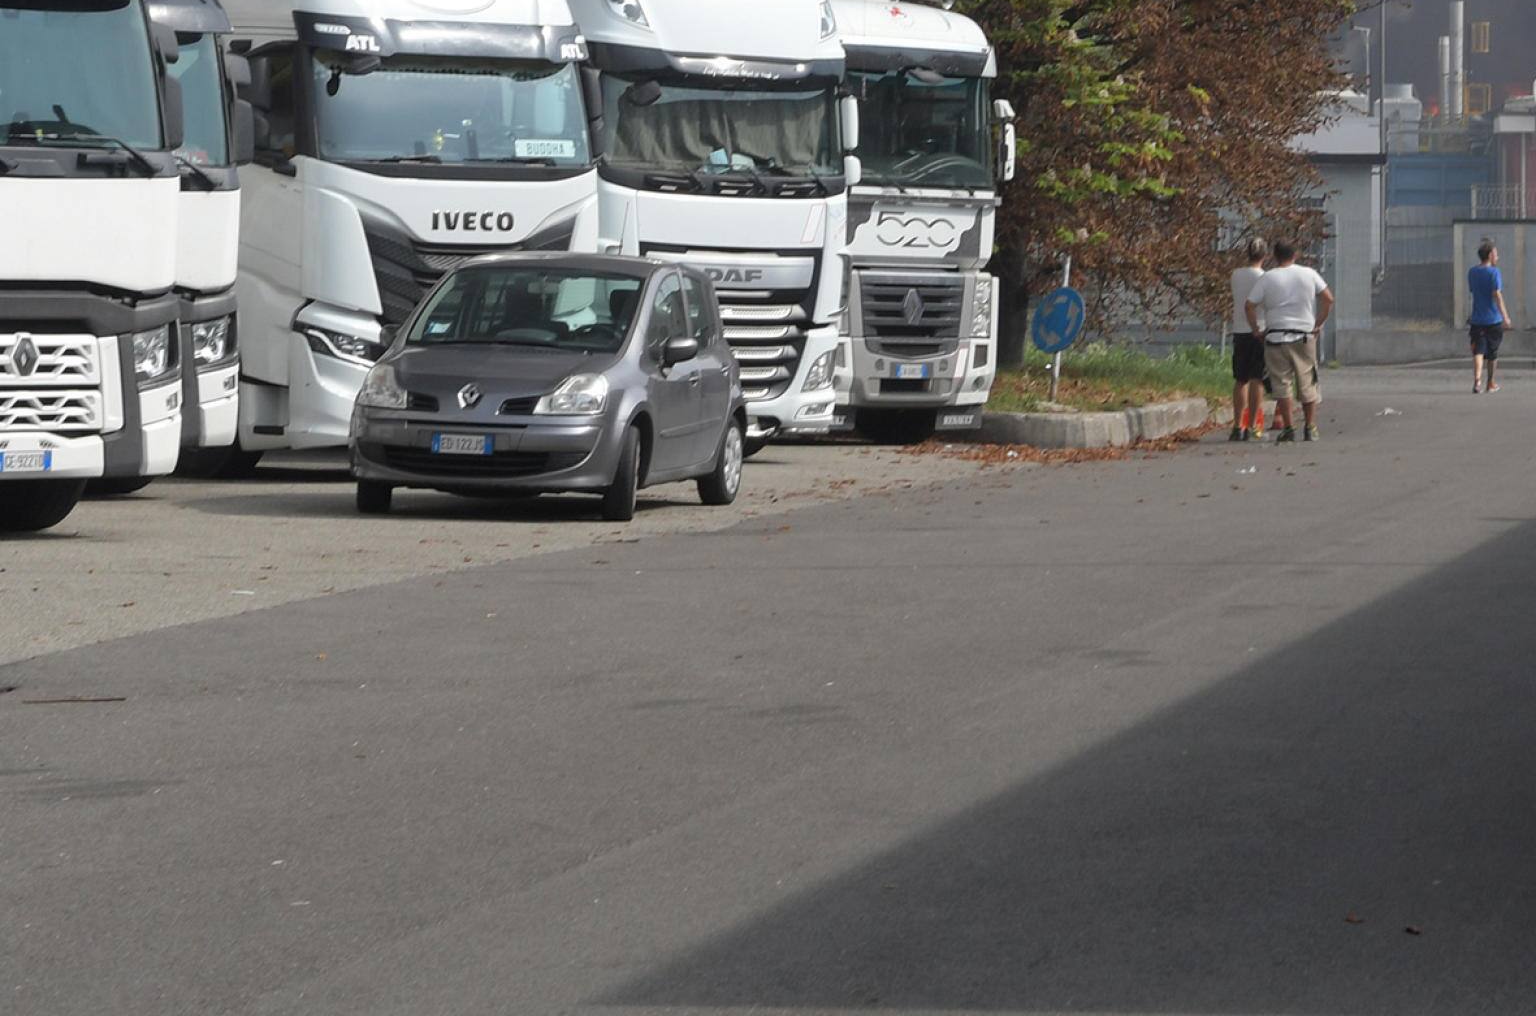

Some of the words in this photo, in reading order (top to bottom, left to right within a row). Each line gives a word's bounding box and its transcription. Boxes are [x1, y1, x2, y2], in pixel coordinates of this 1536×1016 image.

[345, 34, 380, 53] ATL
[431, 211, 515, 232] IVECO
[704, 268, 763, 282] DAF
